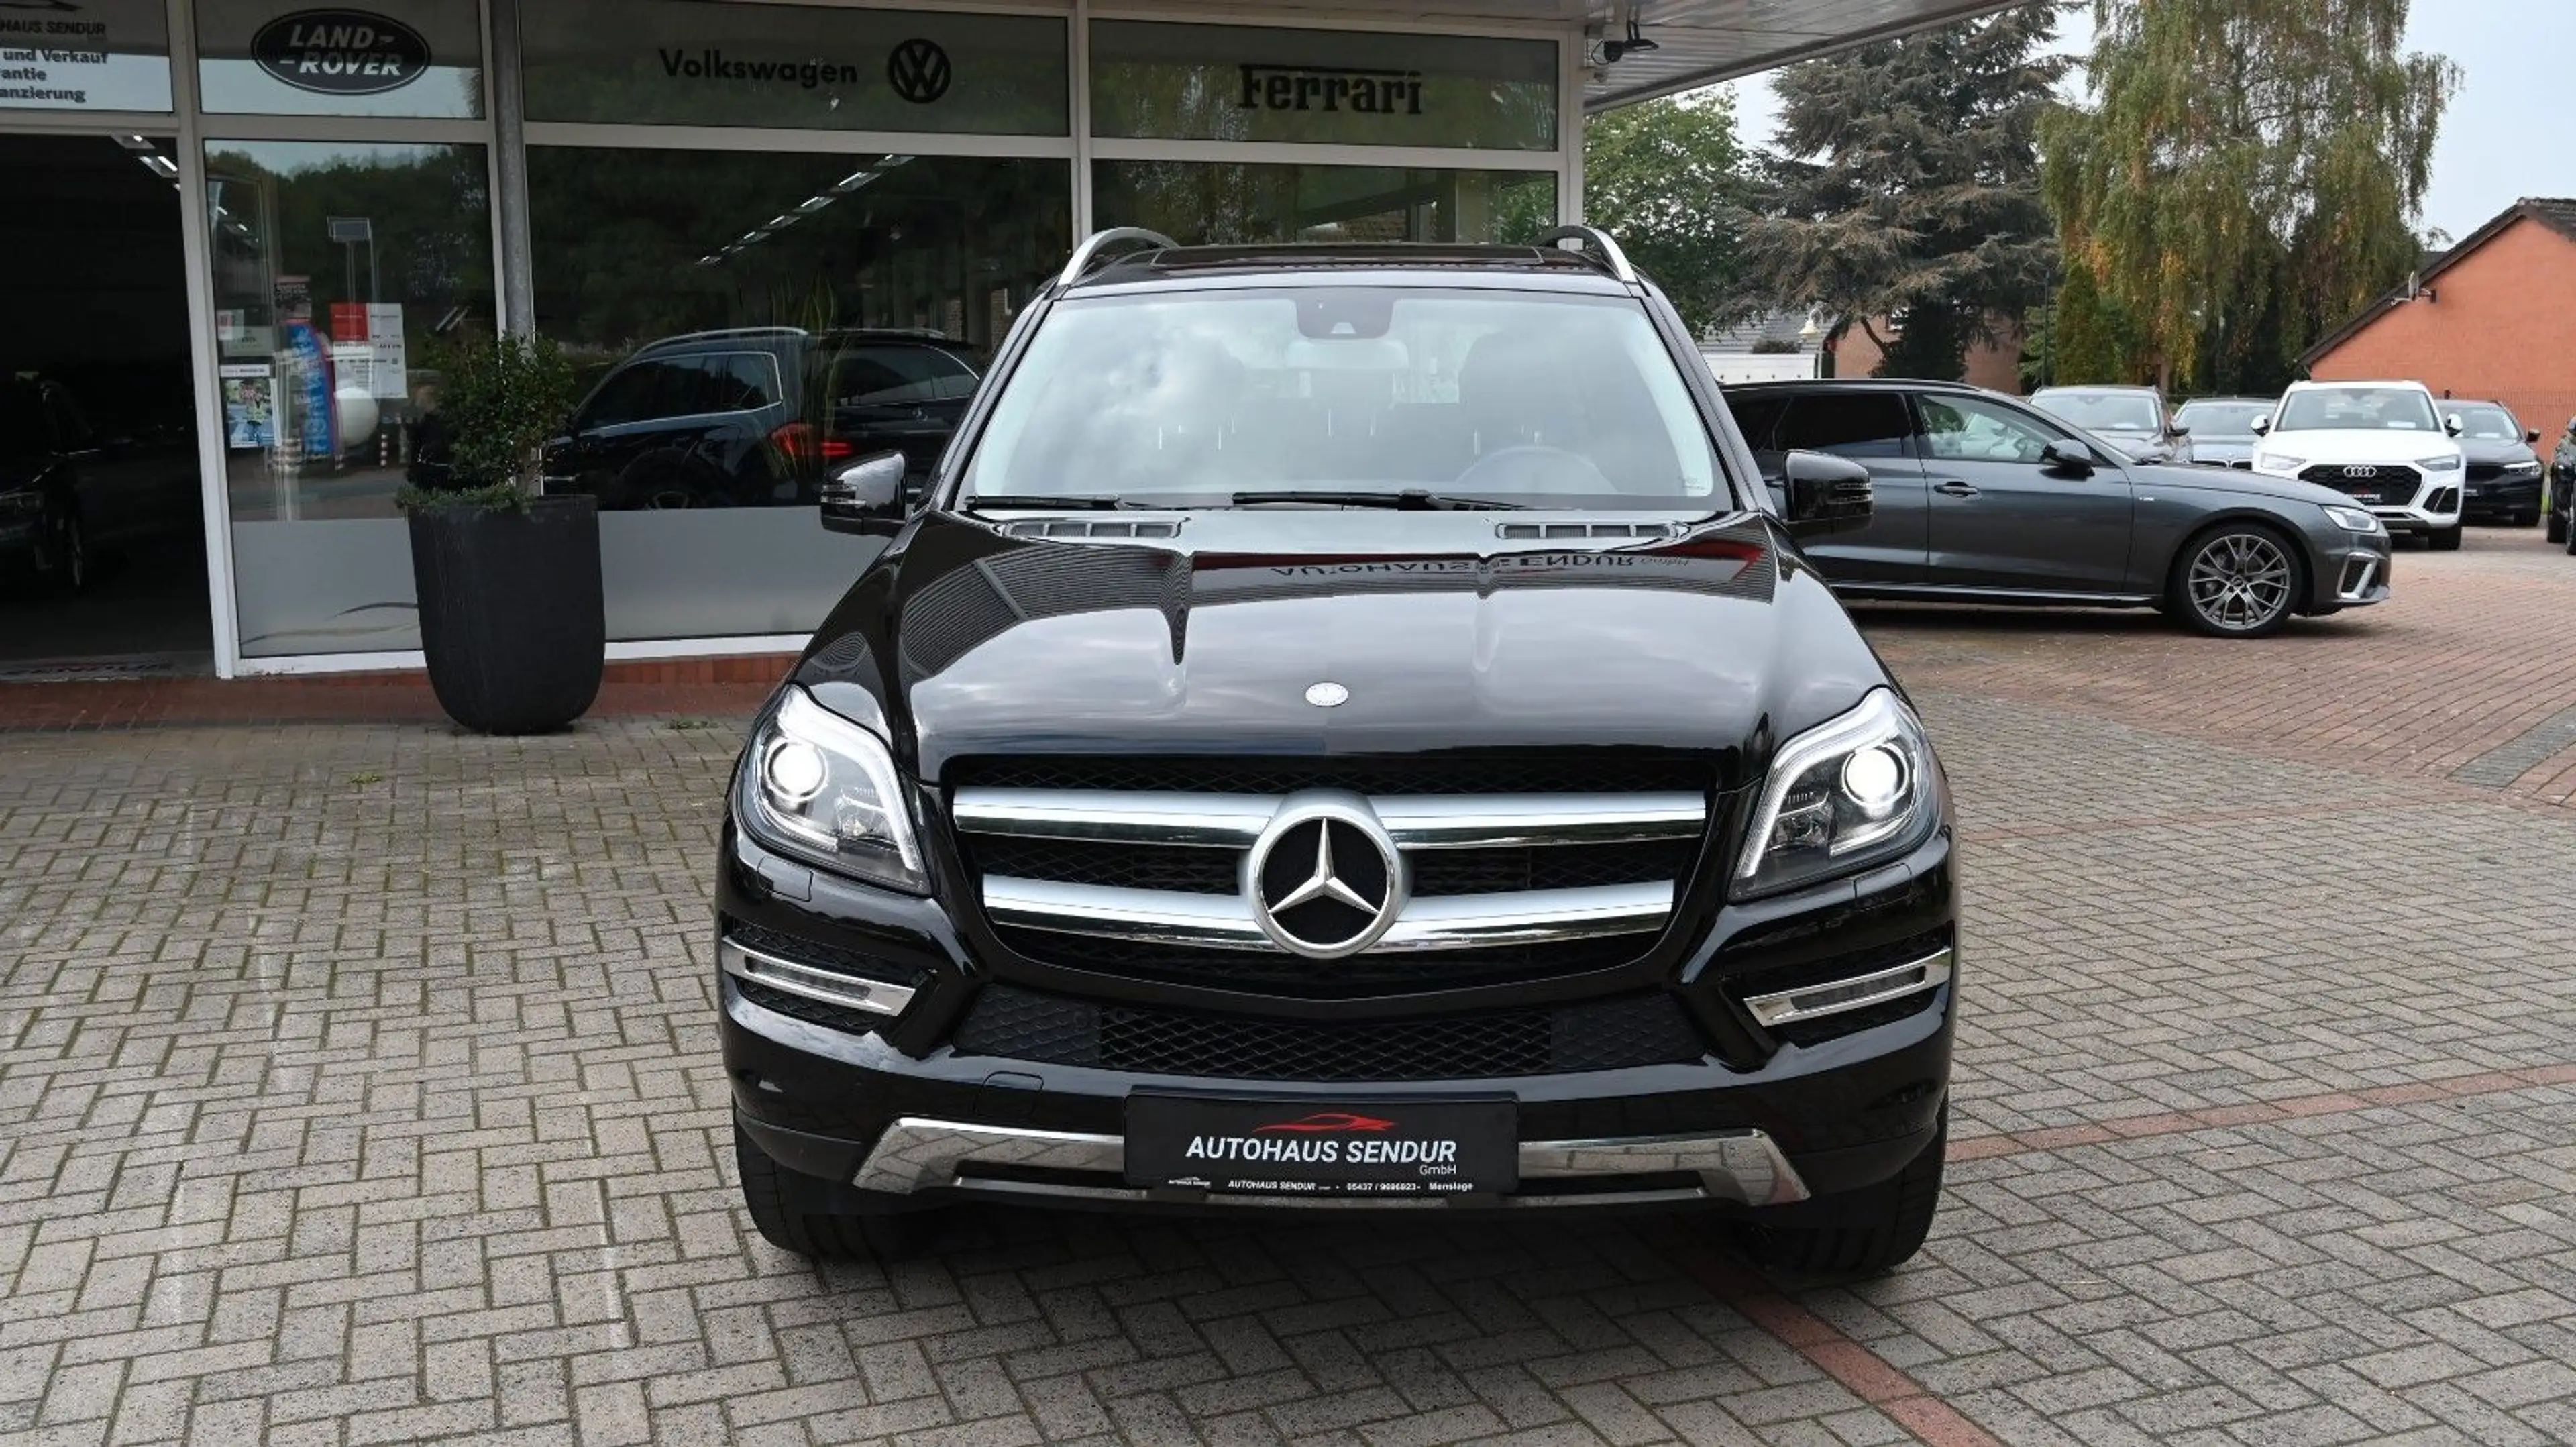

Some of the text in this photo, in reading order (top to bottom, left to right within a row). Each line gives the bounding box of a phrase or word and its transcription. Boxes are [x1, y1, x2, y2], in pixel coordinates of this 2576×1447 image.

[47, 21, 106, 34] SENDUR
[3, 47, 109, 64] und Verkauf
[659, 49, 857, 89] Volkswagen
[1238, 64, 1422, 114] Ferrari
[1185, 1136, 1457, 1164] AUTOHAUS SENDUR
[1419, 1165, 1457, 1175] GmbH
[1228, 1180, 1277, 1189] AUTOHAUS
[1279, 1181, 1317, 1191] SENDUR
